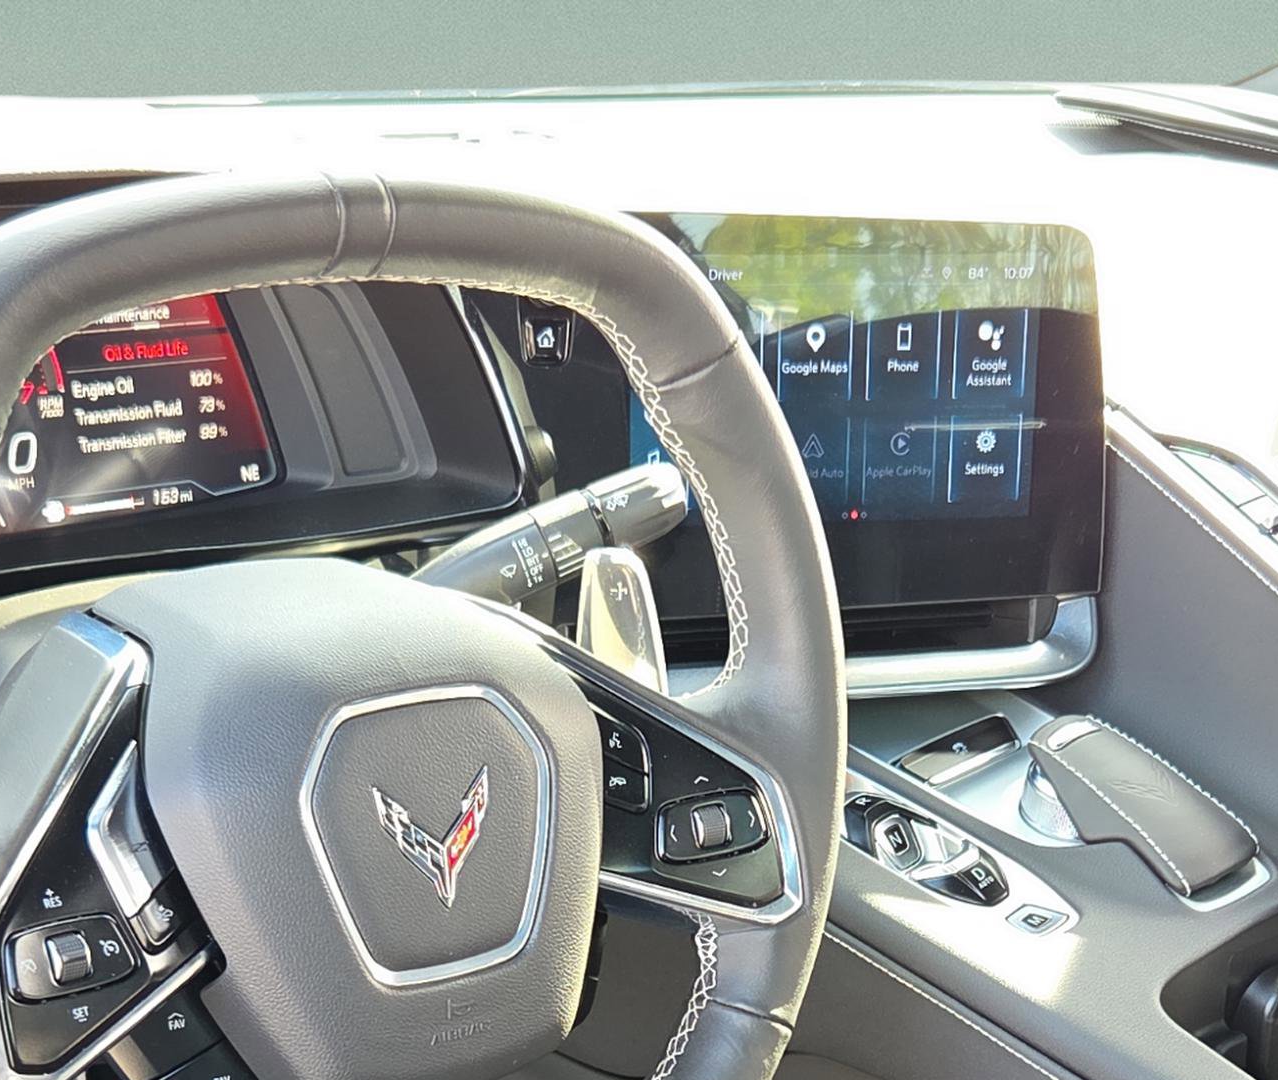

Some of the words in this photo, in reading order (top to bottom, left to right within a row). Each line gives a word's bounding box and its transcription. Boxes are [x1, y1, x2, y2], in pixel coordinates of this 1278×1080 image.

[708, 266, 744, 282] Driver
[103, 345, 122, 361] Oil
[123, 345, 135, 360] &
[135, 342, 164, 358] Fluid
[166, 340, 189, 356] Life
[781, 359, 819, 375] Google
[820, 358, 849, 376] Maps
[887, 359, 919, 374] Phone
[971, 358, 1007, 374] Google
[966, 373, 1012, 386] Assistant
[71, 378, 115, 401] Engine
[114, 375, 135, 394] Oil
[37, 395, 64, 412] RPM
[74, 404, 153, 426] Transmission
[153, 398, 184, 417] Fluid
[77, 432, 156, 454] Transmission
[155, 426, 187, 445] Filter
[8, 431, 38, 475] 0
[239, 463, 261, 482] NE
[821, 467, 845, 479] Auto
[866, 466, 894, 480] Apple
[895, 466, 933, 480] CarPlay
[964, 461, 1005, 478] Settings
[7, 475, 36, 492] MPH
[529, 563, 544, 577] OFF
[888, 832, 904, 848] N
[970, 867, 987, 881] D
[42, 895, 63, 909] RES
[72, 1006, 90, 1020] SET
[168, 1017, 186, 1031] FAV
